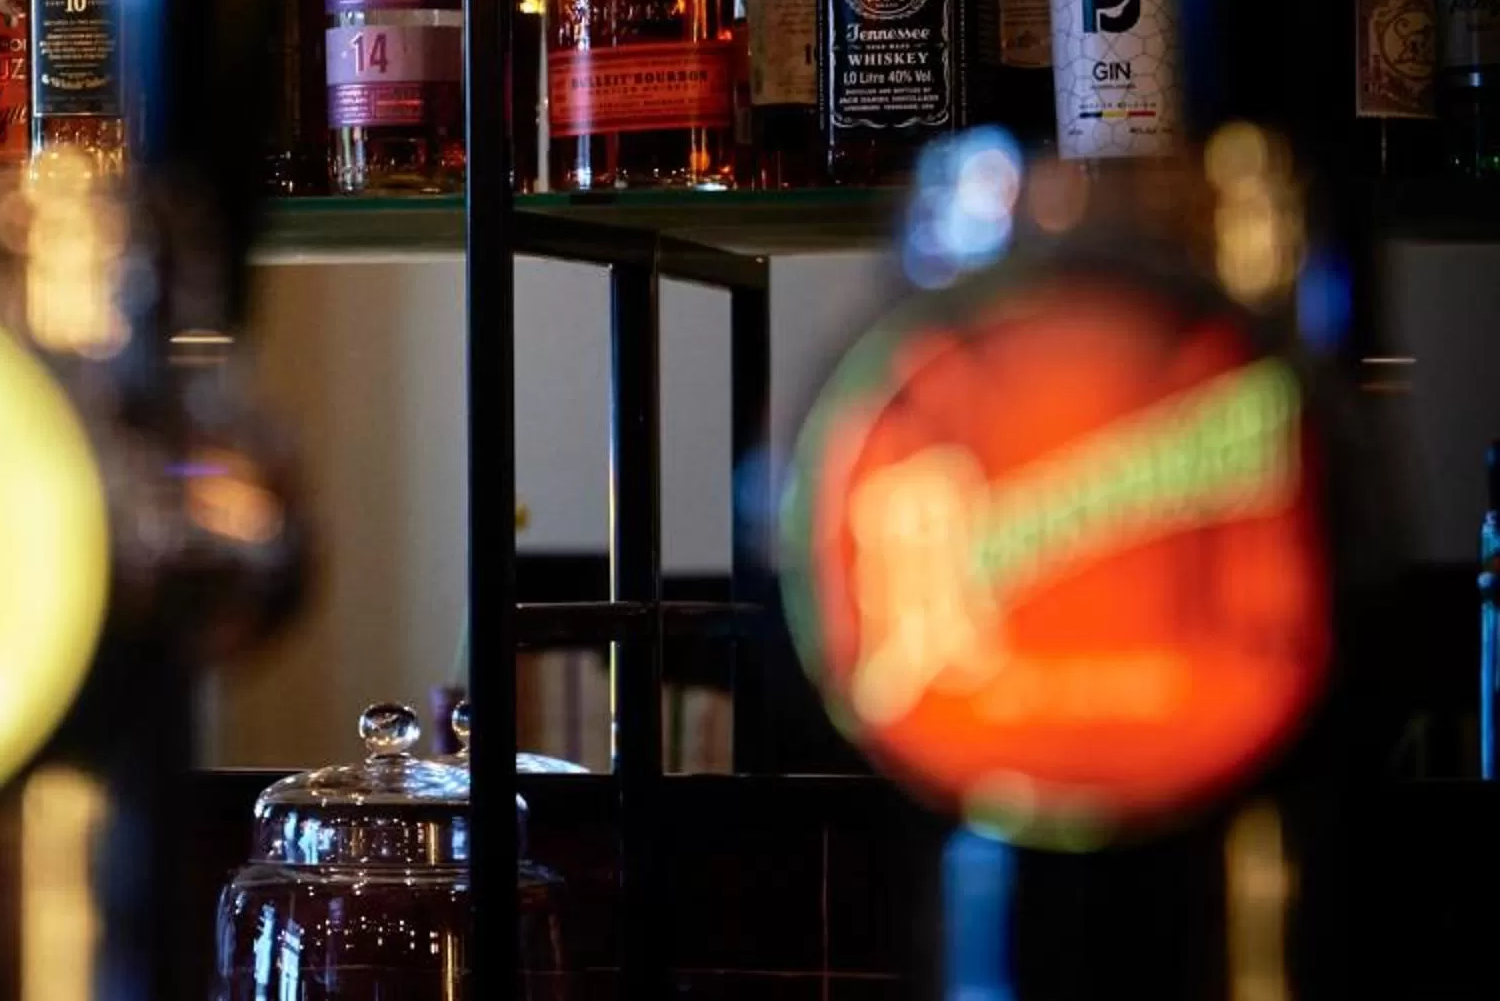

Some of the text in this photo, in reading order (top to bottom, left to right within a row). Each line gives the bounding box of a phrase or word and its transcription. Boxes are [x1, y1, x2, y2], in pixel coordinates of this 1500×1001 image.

[845, 23, 931, 43] Tennessee
[354, 33, 389, 74] 14
[847, 52, 929, 67] WHISKEY
[860, 70, 885, 84] Litre
[887, 70, 913, 83] 40%
[1091, 61, 1132, 81] GIN
